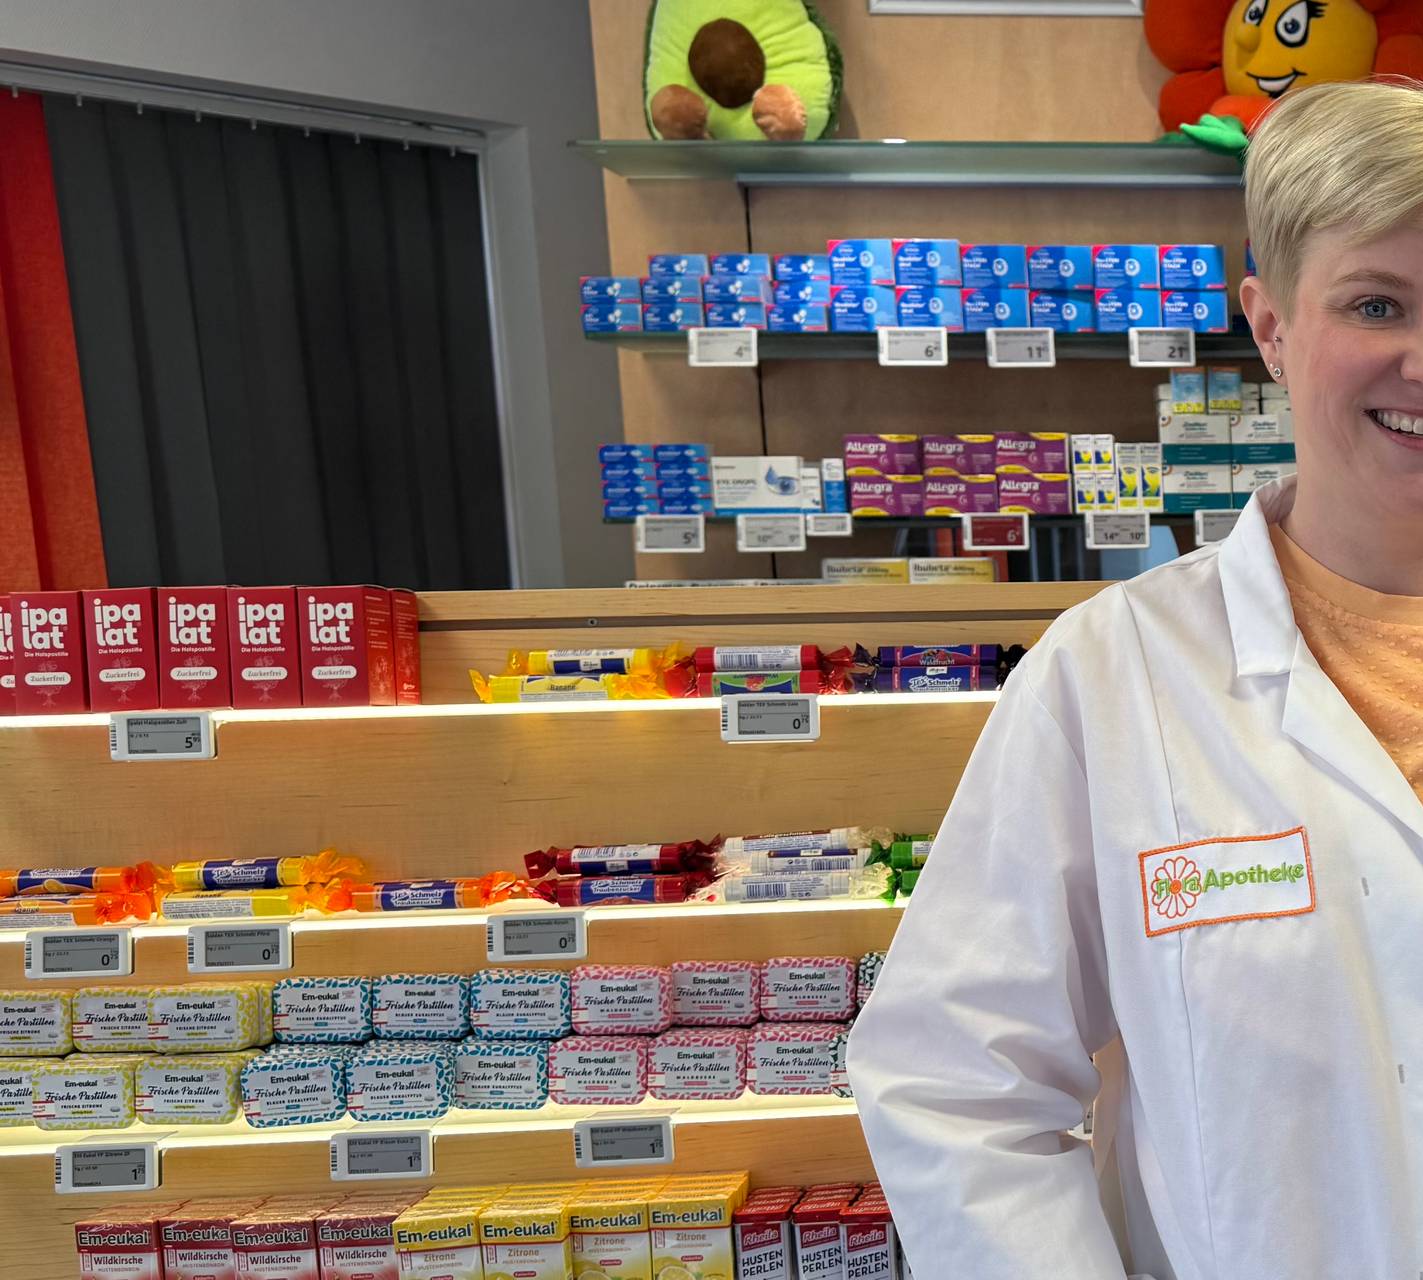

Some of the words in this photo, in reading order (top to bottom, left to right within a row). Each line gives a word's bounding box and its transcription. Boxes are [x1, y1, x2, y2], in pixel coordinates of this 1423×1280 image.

[846, 441, 886, 454] Allegra
[924, 441, 963, 454] Allegra
[852, 481, 892, 494] Allegra
[1000, 479, 1040, 492] Allegra
[21, 600, 67, 626] ipa
[93, 598, 141, 624] ipa
[238, 596, 285, 623] ipa
[308, 596, 354, 622] ipa
[22, 627, 64, 649] lat
[96, 624, 139, 646] lat
[239, 623, 282, 645] lat
[309, 622, 351, 644] lat
[30, 674, 66, 683] Zuckerfrei
[175, 668, 212, 678] Zuckerfrei
[316, 667, 351, 678] Zuckerfrei
[1202, 862, 1304, 893] Apotheke
[789, 972, 826, 981] Em-eukal
[502, 988, 539, 998] Em-eukal
[177, 1001, 215, 1011] Em-eukal
[485, 1001, 515, 1012] Frische
[517, 999, 555, 1011] Pastillen
[160, 1013, 189, 1025] Frische
[191, 1012, 232, 1025] Pastillen
[375, 1070, 414, 1079] Em-eukal
[660, 1063, 691, 1075] Frische
[693, 1062, 730, 1073] Pastillen
[65, 1080, 98, 1088] Em-eukal
[45, 1091, 75, 1103] Frische
[77, 1090, 118, 1101] Pastillen
[652, 1207, 723, 1224] Em-eukal
[235, 1229, 307, 1245] Em-eukal
[484, 1223, 555, 1238] Em-eukal
[744, 1228, 779, 1246] Rheila
[848, 1228, 884, 1246] Rheila
[79, 1232, 149, 1246] Em-eukal
[675, 1233, 707, 1242] Zitrone
[250, 1255, 301, 1264] Wildkirsche
[335, 1250, 386, 1260] Wildkirsche
[507, 1248, 539, 1258] Zitrone
[742, 1249, 783, 1266] HUSTEN
[847, 1250, 888, 1267] HUSTEN
[93, 1255, 143, 1265] Wildkirsche
[743, 1260, 784, 1277] PERLEN
[848, 1261, 889, 1279] PERLEN
